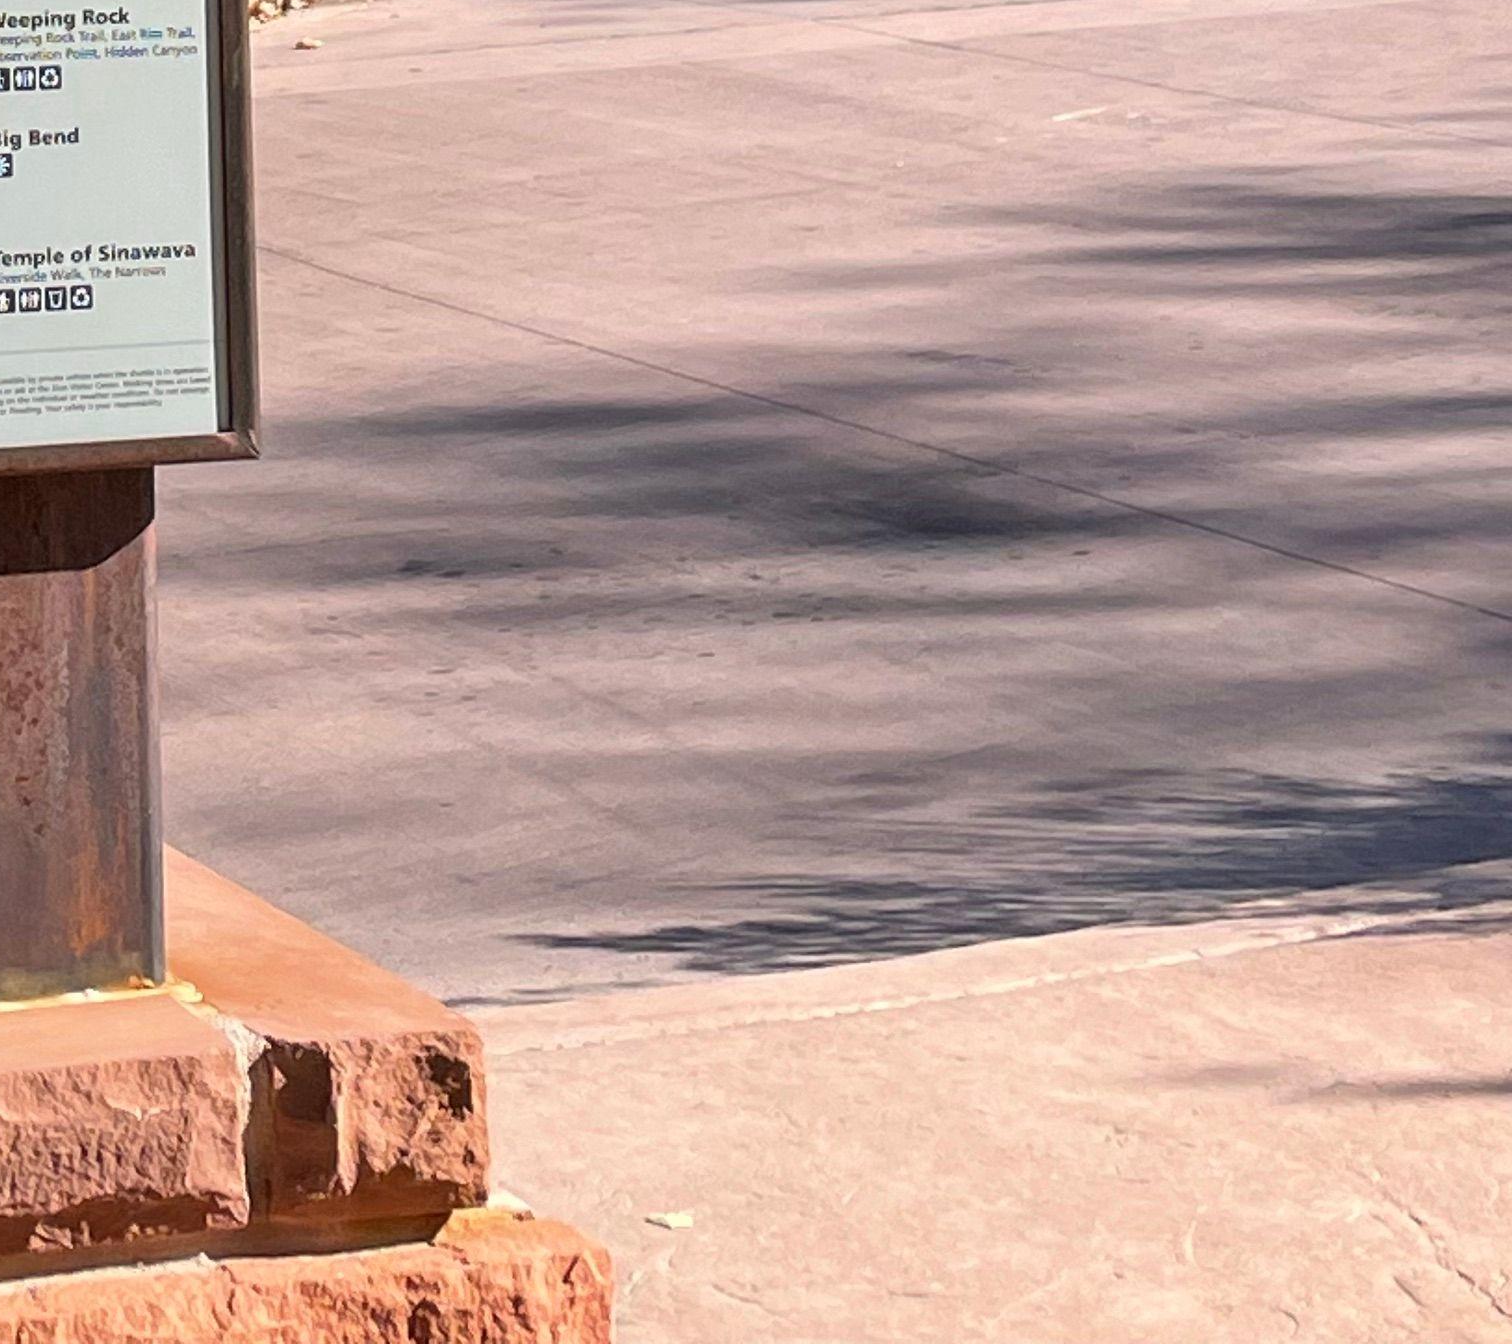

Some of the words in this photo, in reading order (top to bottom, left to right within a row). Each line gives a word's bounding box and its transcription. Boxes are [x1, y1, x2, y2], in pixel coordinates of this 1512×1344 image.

[82, 7, 129, 24] Rock
[29, 127, 78, 145] Bend
[70, 245, 91, 262] of
[98, 244, 195, 261] Sinawava
